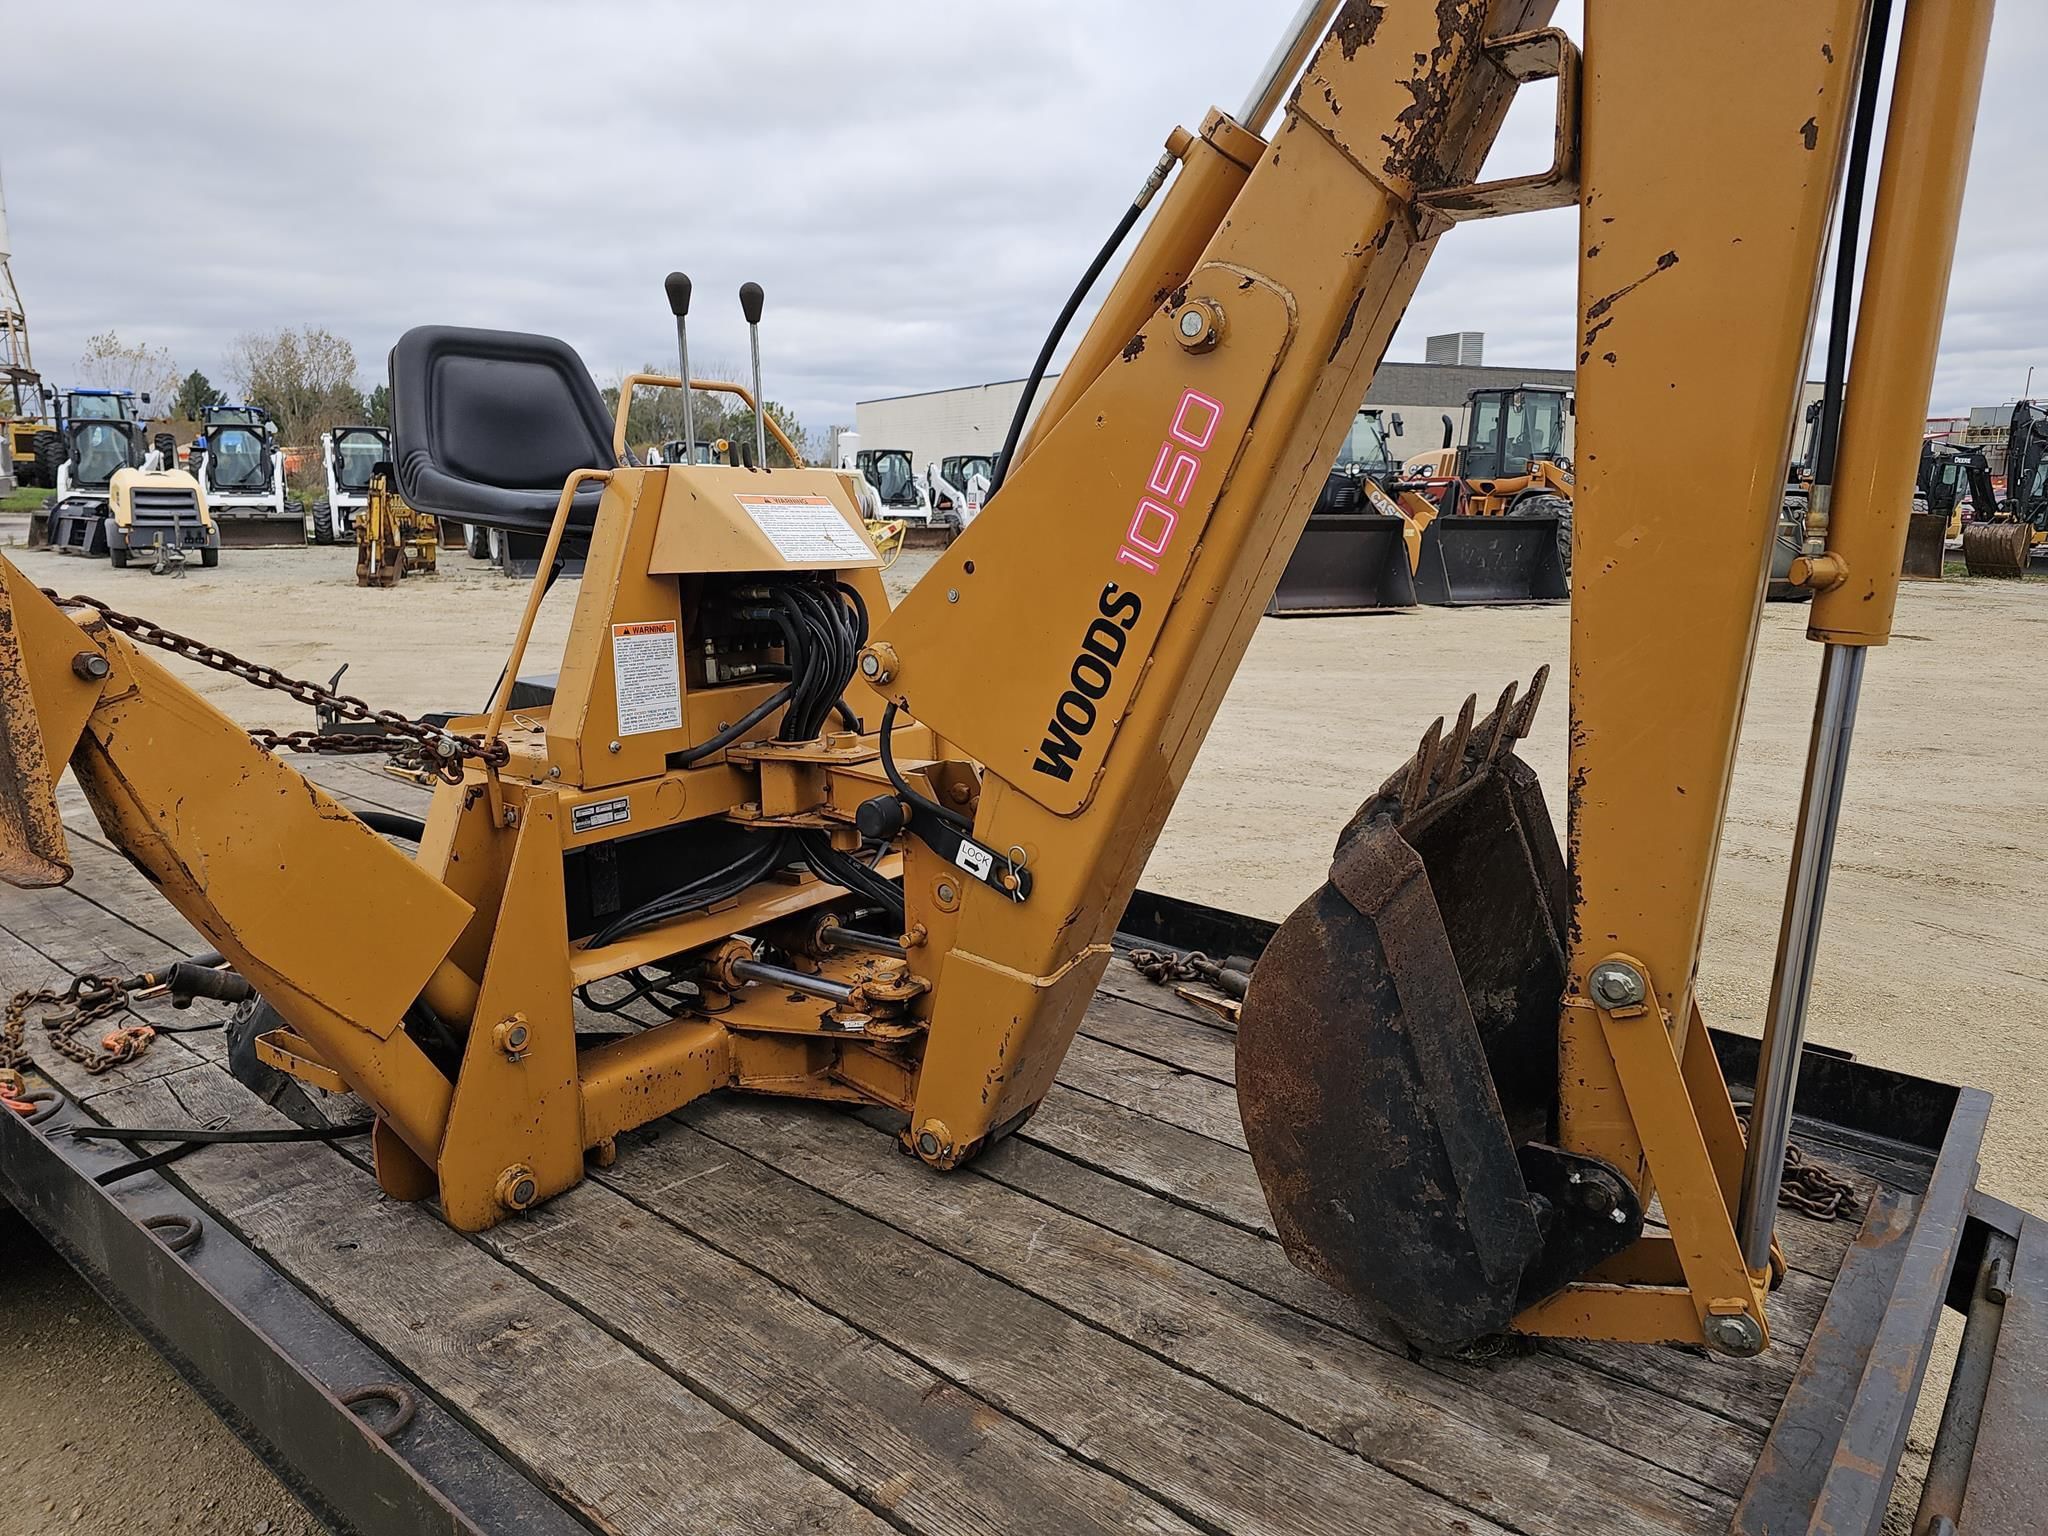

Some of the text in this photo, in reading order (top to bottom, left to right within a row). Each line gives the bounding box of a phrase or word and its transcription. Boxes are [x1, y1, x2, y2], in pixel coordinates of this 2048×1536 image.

[1032, 387, 1224, 783] WOODS 1050
[632, 625, 667, 635] WARNING
[961, 843, 990, 866] LOCK
